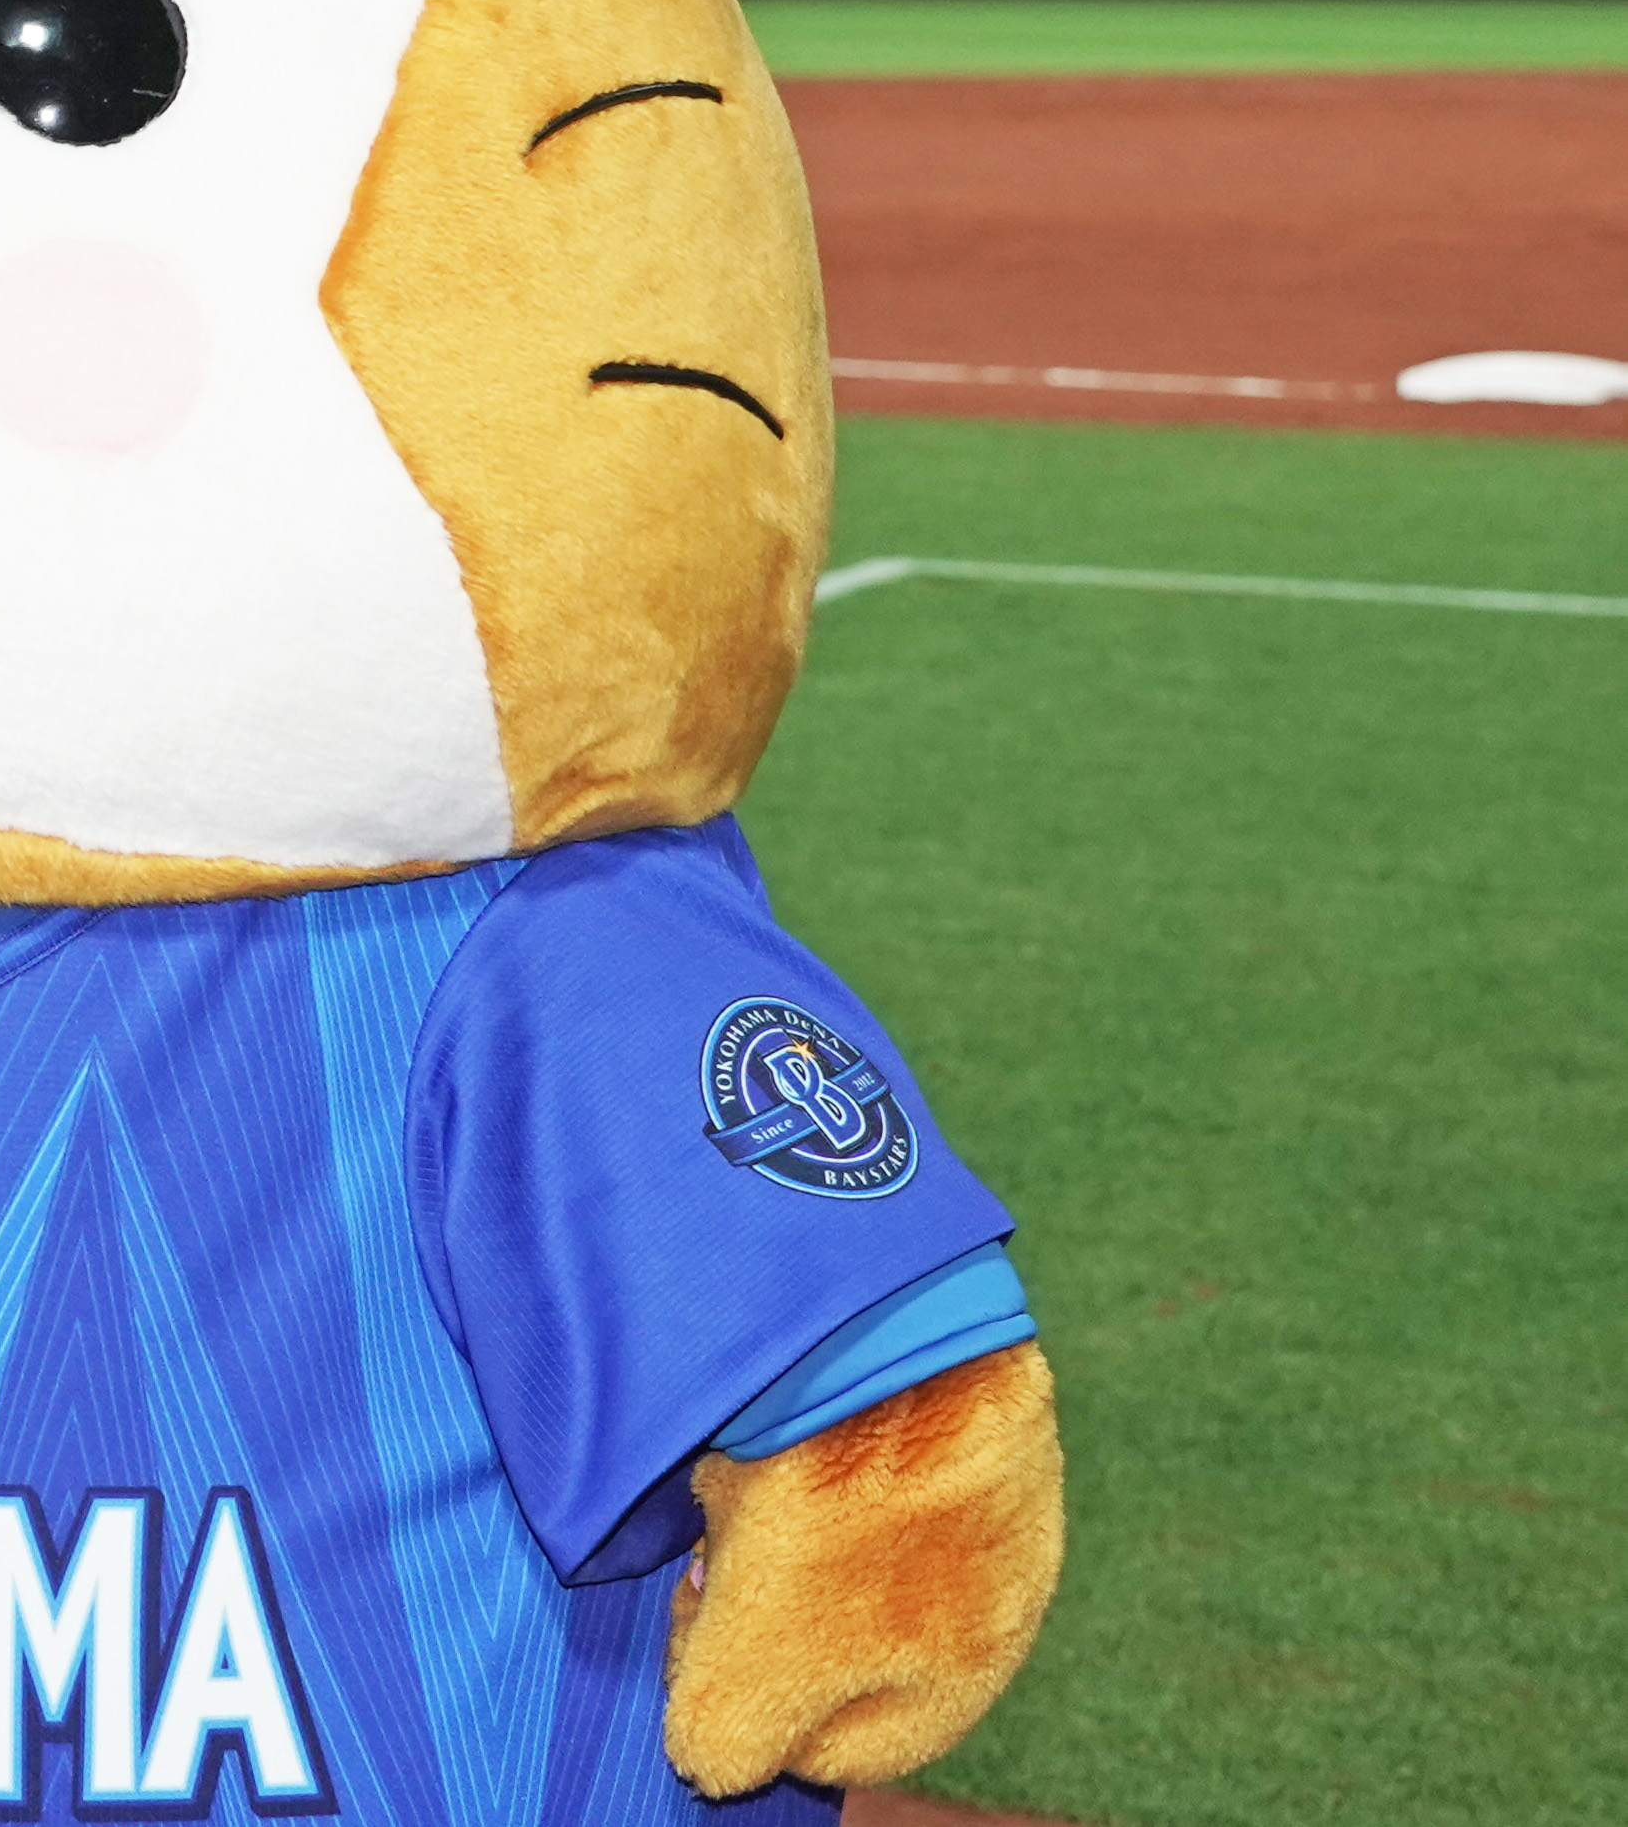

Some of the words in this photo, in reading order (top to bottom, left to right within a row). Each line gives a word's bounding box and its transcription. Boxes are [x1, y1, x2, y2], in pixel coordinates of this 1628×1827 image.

[714, 1009, 778, 1105] YOKOHAMA
[751, 1117, 794, 1145] Since
[823, 1133, 908, 1188] BAYSTARS
